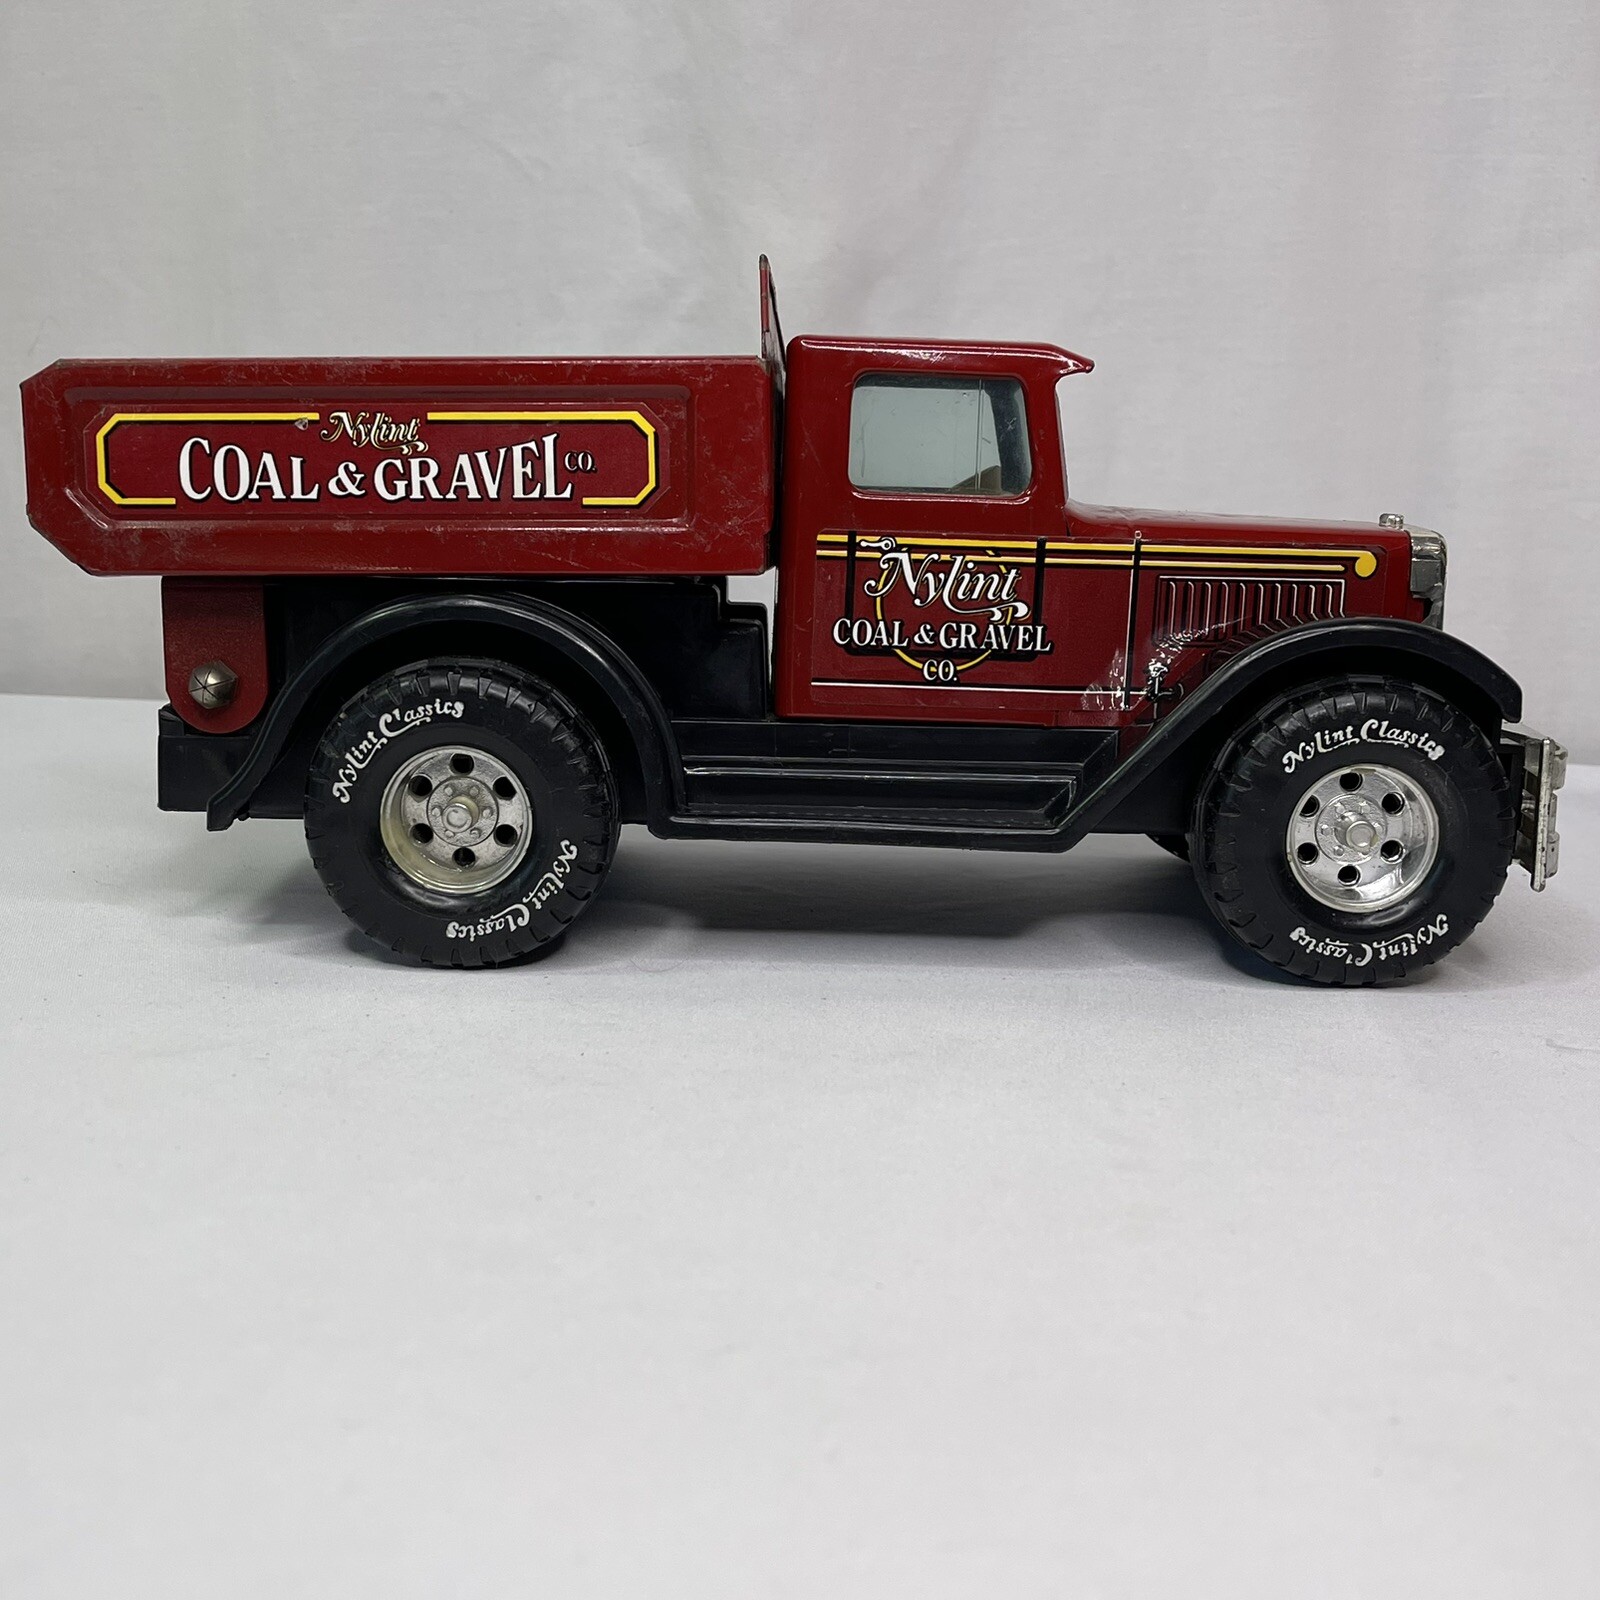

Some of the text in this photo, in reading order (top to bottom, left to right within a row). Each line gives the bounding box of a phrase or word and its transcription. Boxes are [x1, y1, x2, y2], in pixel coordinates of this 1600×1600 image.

[320, 410, 428, 453] Nylint
[178, 433, 597, 501] COAL & GRAVEL CO.
[863, 550, 1030, 621] Nylint
[833, 618, 1051, 651] COAL & GRAVEL
[923, 659, 958, 682] CO.
[332, 698, 465, 804] Nylint Classics
[1282, 718, 1445, 774] Nylint Classics
[445, 839, 578, 942] Nylint Classics
[1290, 913, 1449, 967] Nylint Classics
